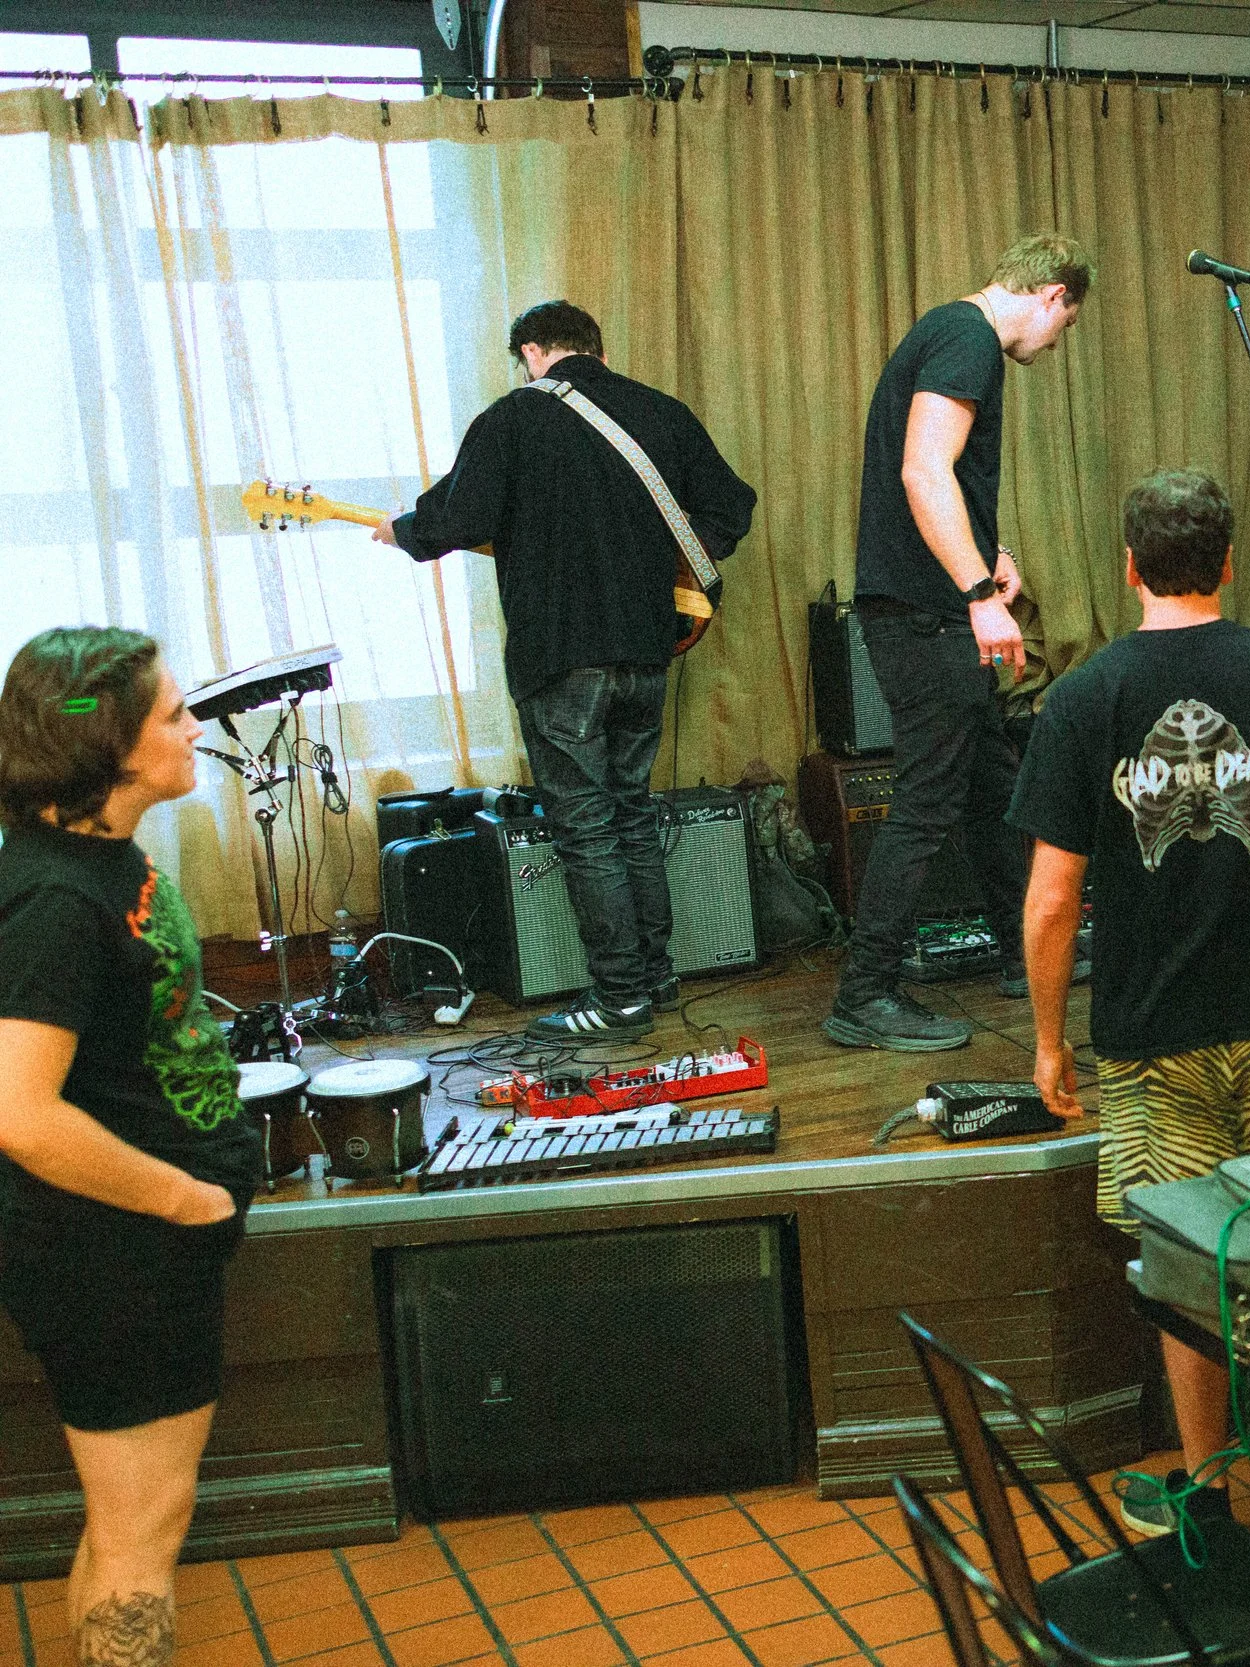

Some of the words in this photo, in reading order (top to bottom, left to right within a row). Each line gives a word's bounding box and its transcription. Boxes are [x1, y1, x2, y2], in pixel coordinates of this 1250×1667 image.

[1174, 762, 1191, 787] TO
[1194, 762, 1211, 786] BE
[953, 1121, 978, 1135] CABLE
[979, 1104, 1018, 1128] COMPANY
[963, 1099, 1006, 1121] AMERICAN
